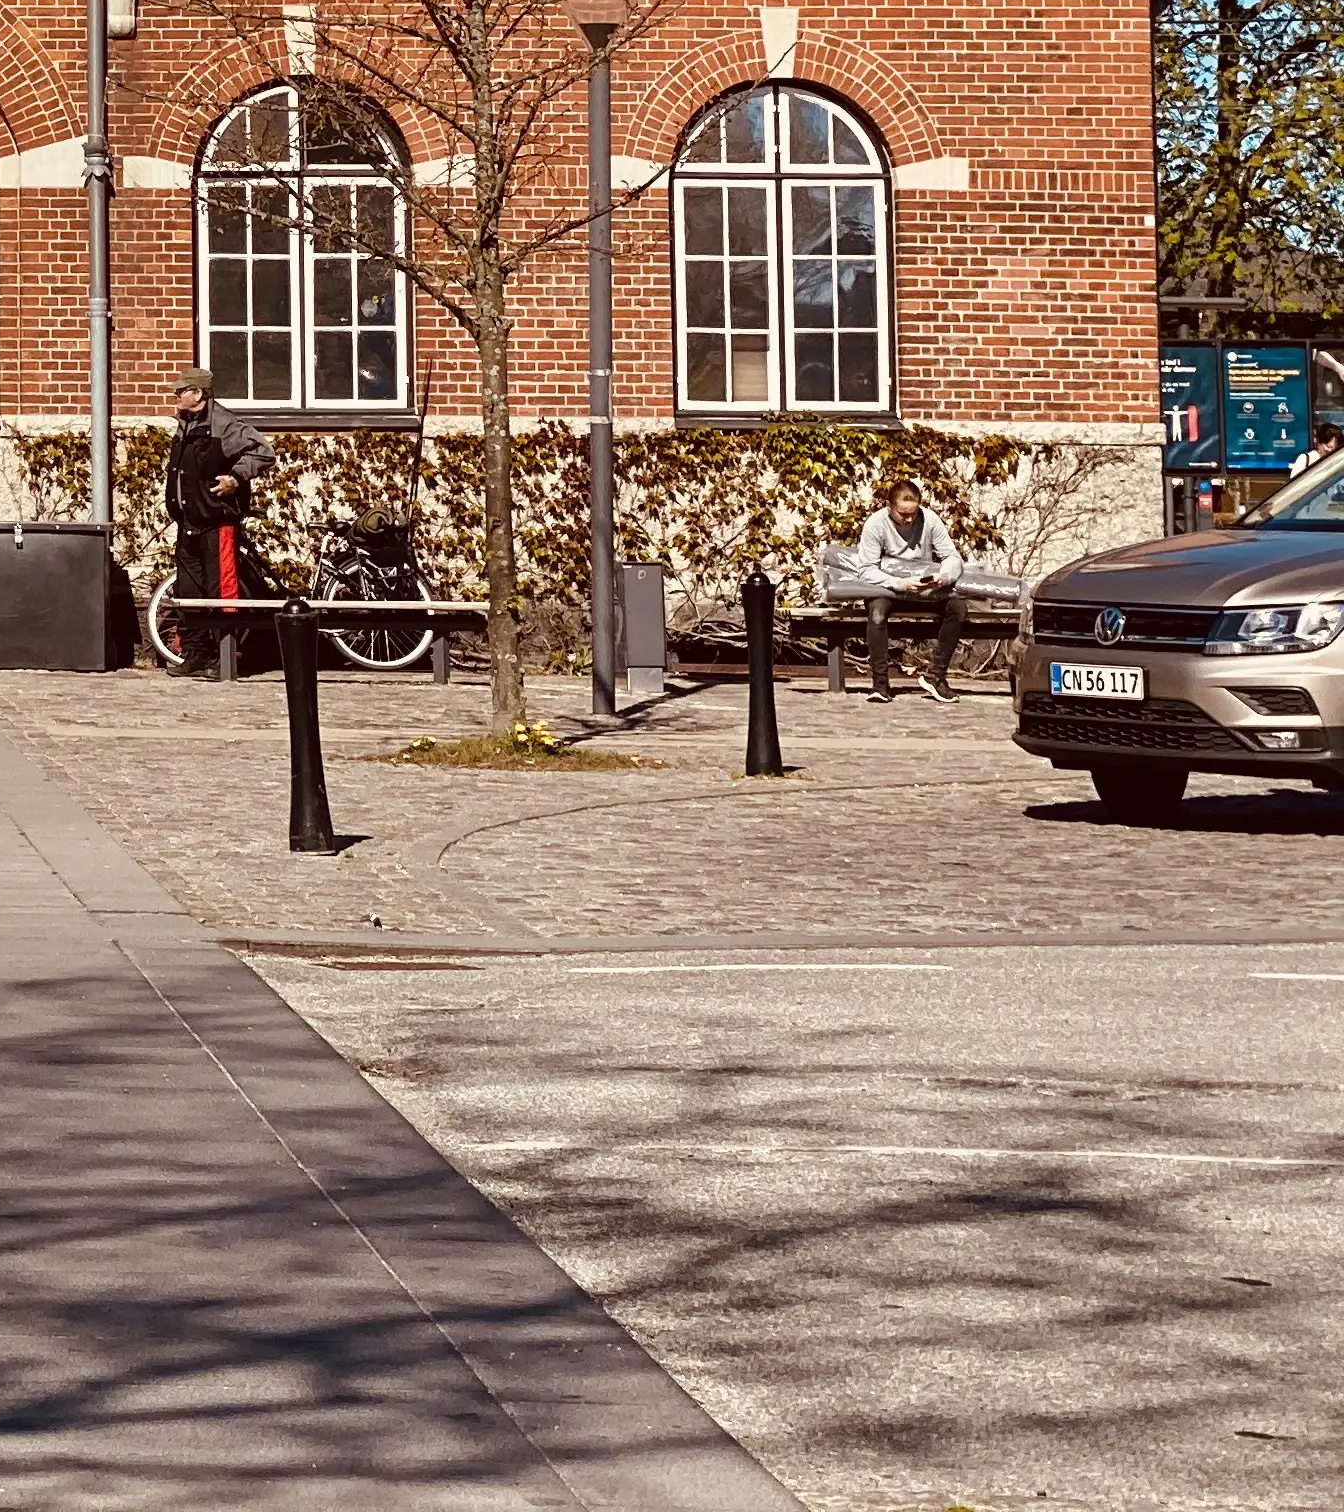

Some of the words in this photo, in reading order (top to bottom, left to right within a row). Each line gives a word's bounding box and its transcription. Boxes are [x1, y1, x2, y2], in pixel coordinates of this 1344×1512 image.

[1062, 669, 1082, 691] CN
[1086, 670, 1105, 692] 56
[1110, 672, 1139, 694] 117
